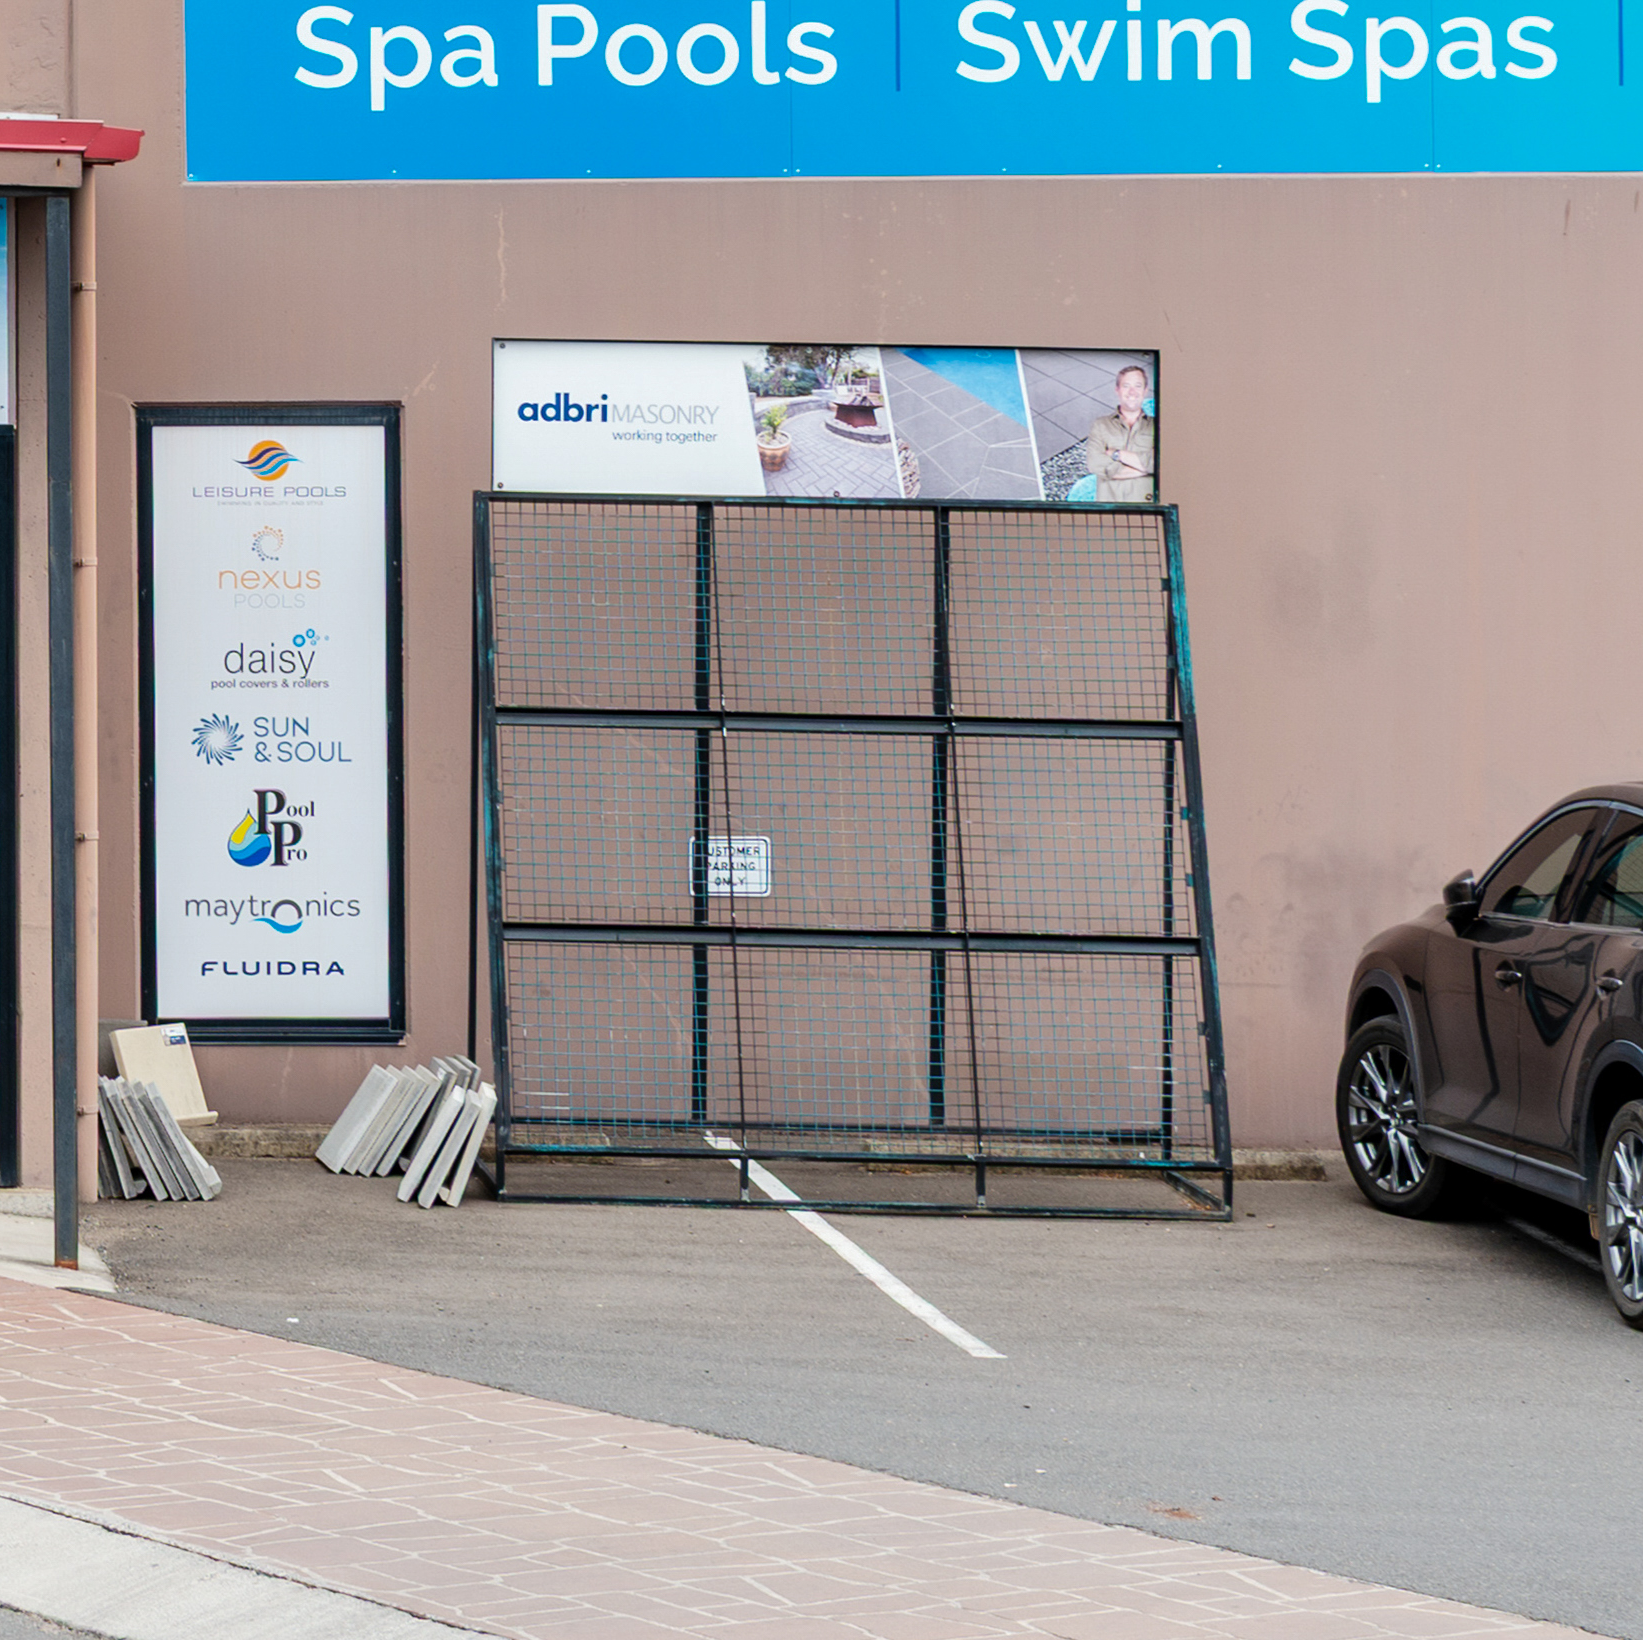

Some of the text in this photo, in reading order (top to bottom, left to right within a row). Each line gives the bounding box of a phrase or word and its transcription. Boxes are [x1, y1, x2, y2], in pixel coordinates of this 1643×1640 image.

[294, 5, 499, 111] Spa
[536, 1, 839, 87] Pools
[517, 392, 719, 425] adbri MASONRY
[612, 430, 718, 444] working together
[192, 486, 347, 498] LEISURE POOLS
[218, 569, 321, 590] nexus
[233, 593, 306, 609] POOLS
[224, 642, 316, 679] daisy
[211, 678, 330, 690] pool covers & rollers
[253, 716, 309, 737] SUN
[254, 741, 352, 762] & SOUL
[254, 789, 315, 835] Pool
[270, 821, 307, 866] Pro
[707, 846, 760, 856] USTOMER
[184, 891, 360, 925] maytronics
[201, 961, 344, 976] FLUIDRA
